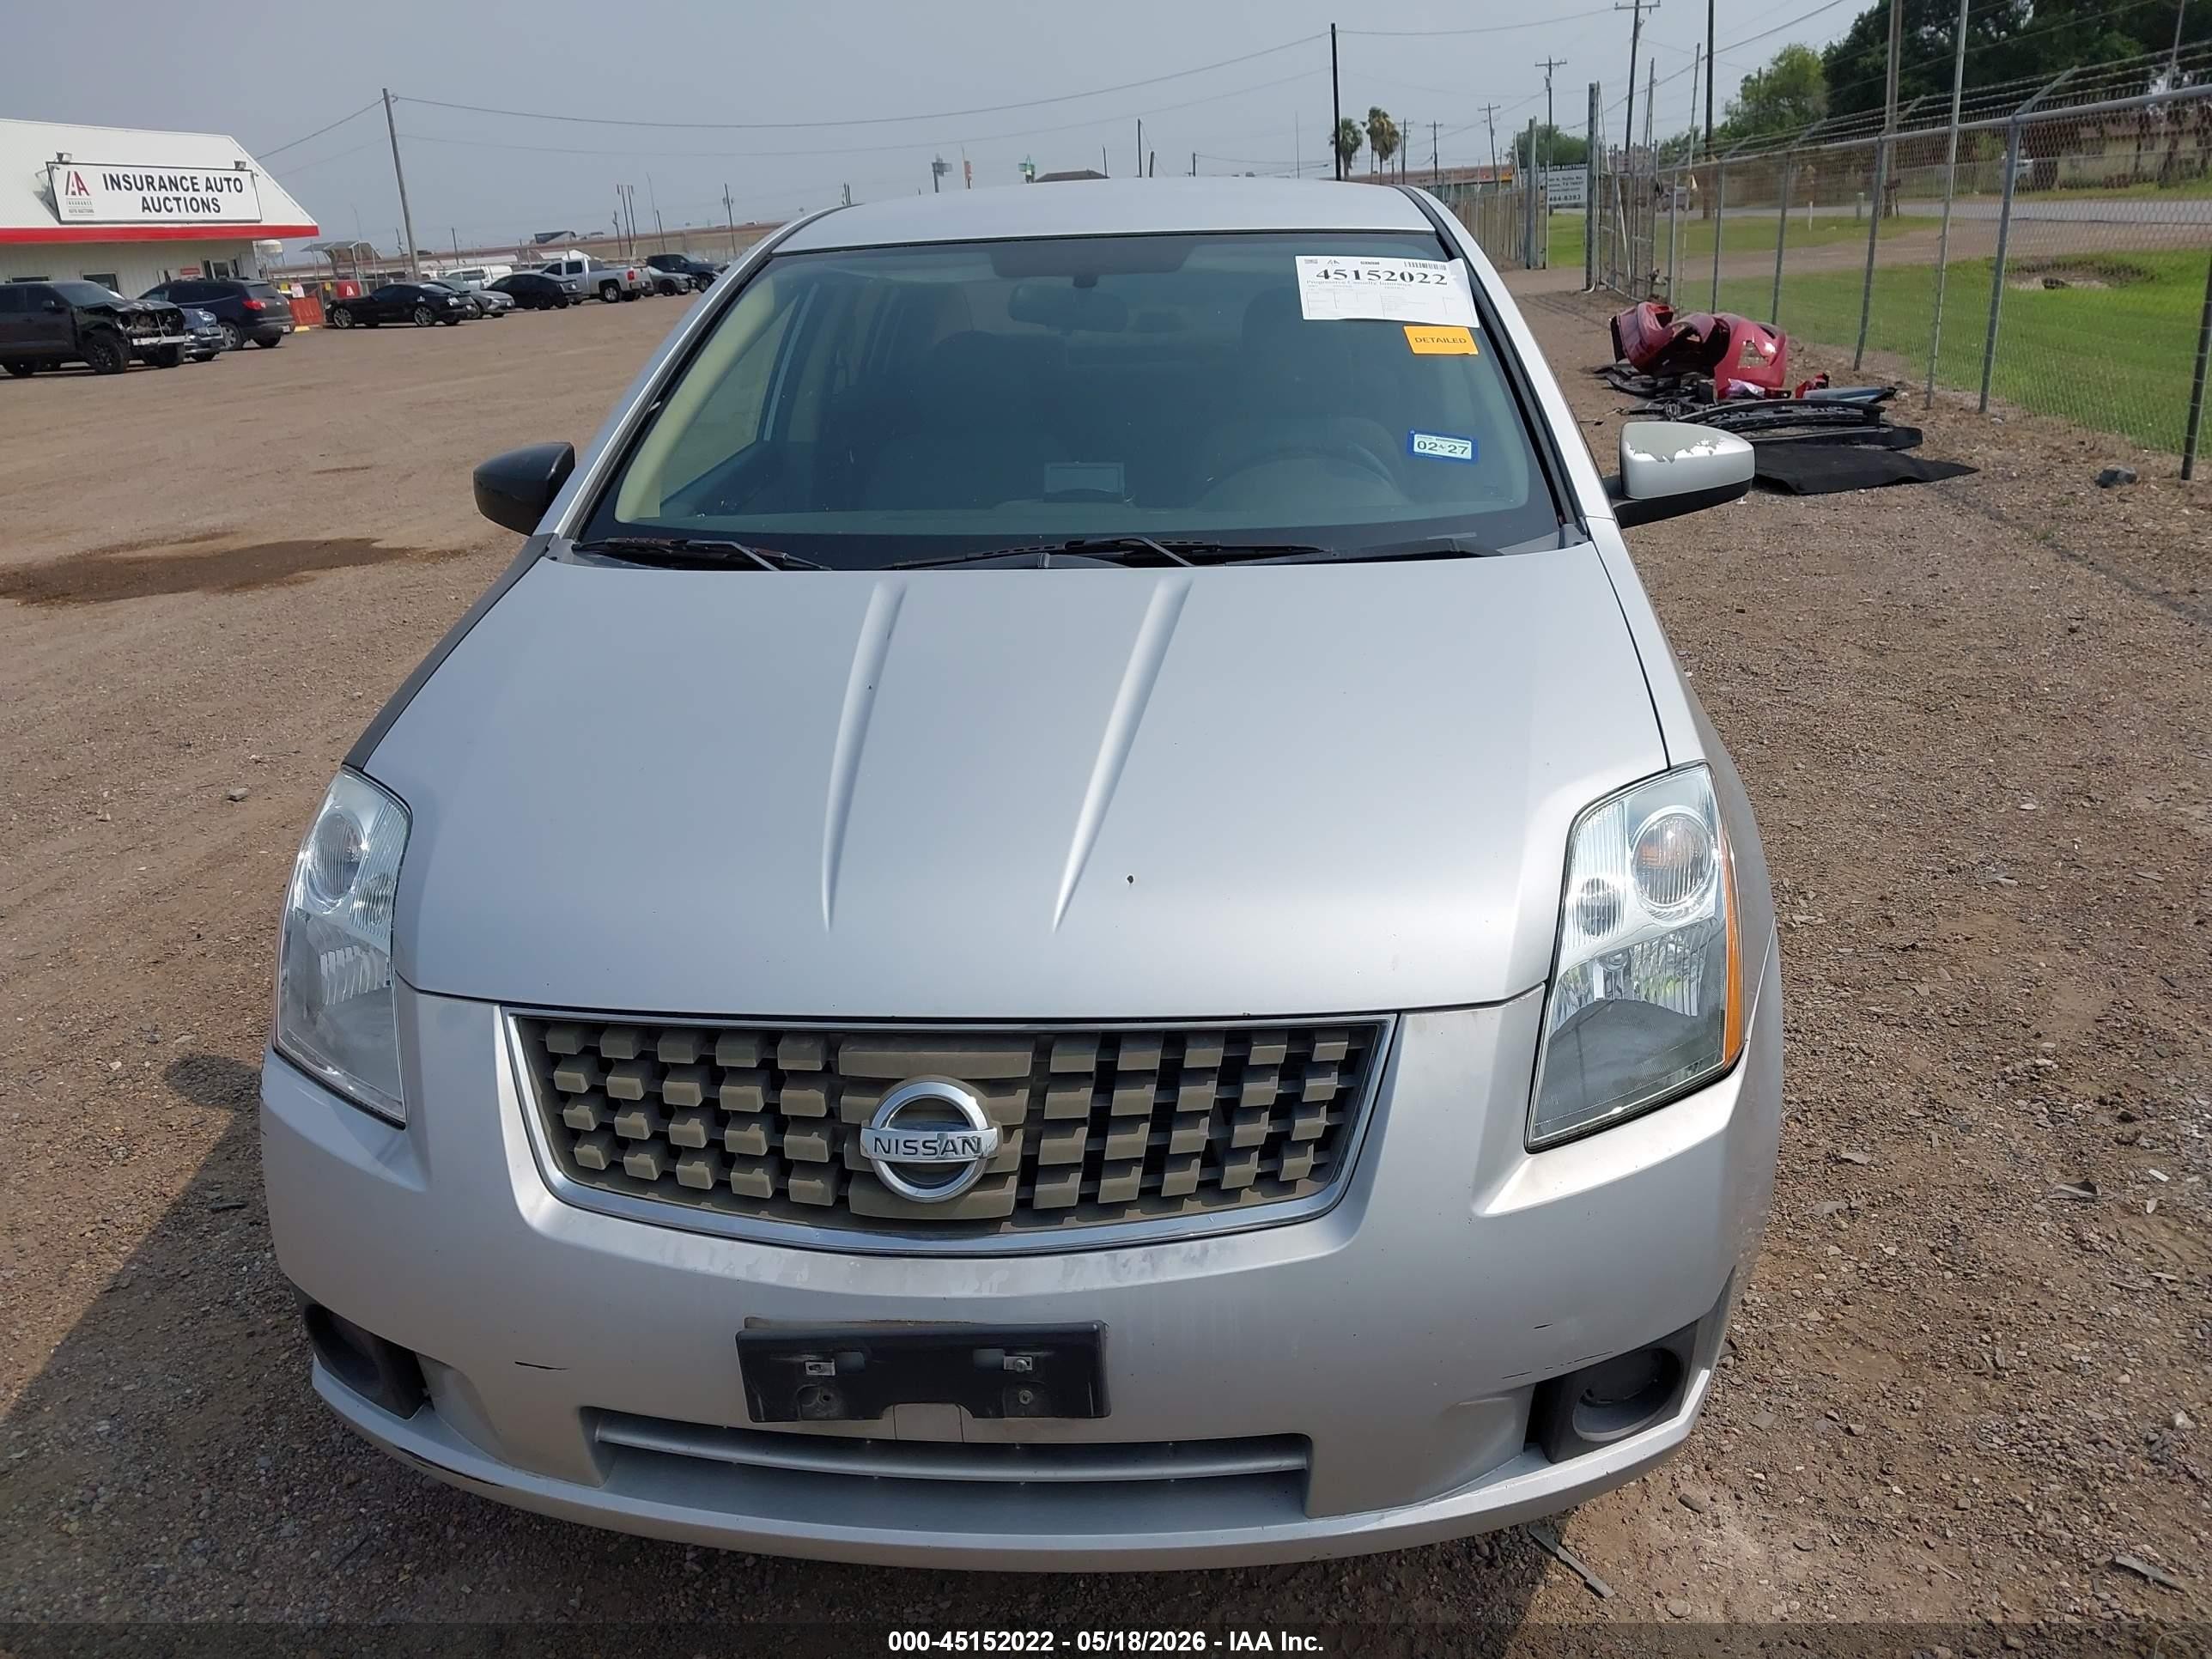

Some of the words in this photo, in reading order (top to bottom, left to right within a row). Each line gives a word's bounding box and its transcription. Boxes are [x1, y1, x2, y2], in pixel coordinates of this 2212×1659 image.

[102, 172, 200, 193] INSURANCE
[204, 175, 244, 194] AUTO
[141, 196, 222, 214] AUCTIONS
[1316, 269, 1448, 285] 45152022
[1414, 336, 1468, 344] DETAILED
[1417, 441, 1438, 452] 02
[1448, 444, 1468, 455] 27
[873, 1136, 982, 1156] NISSAN
